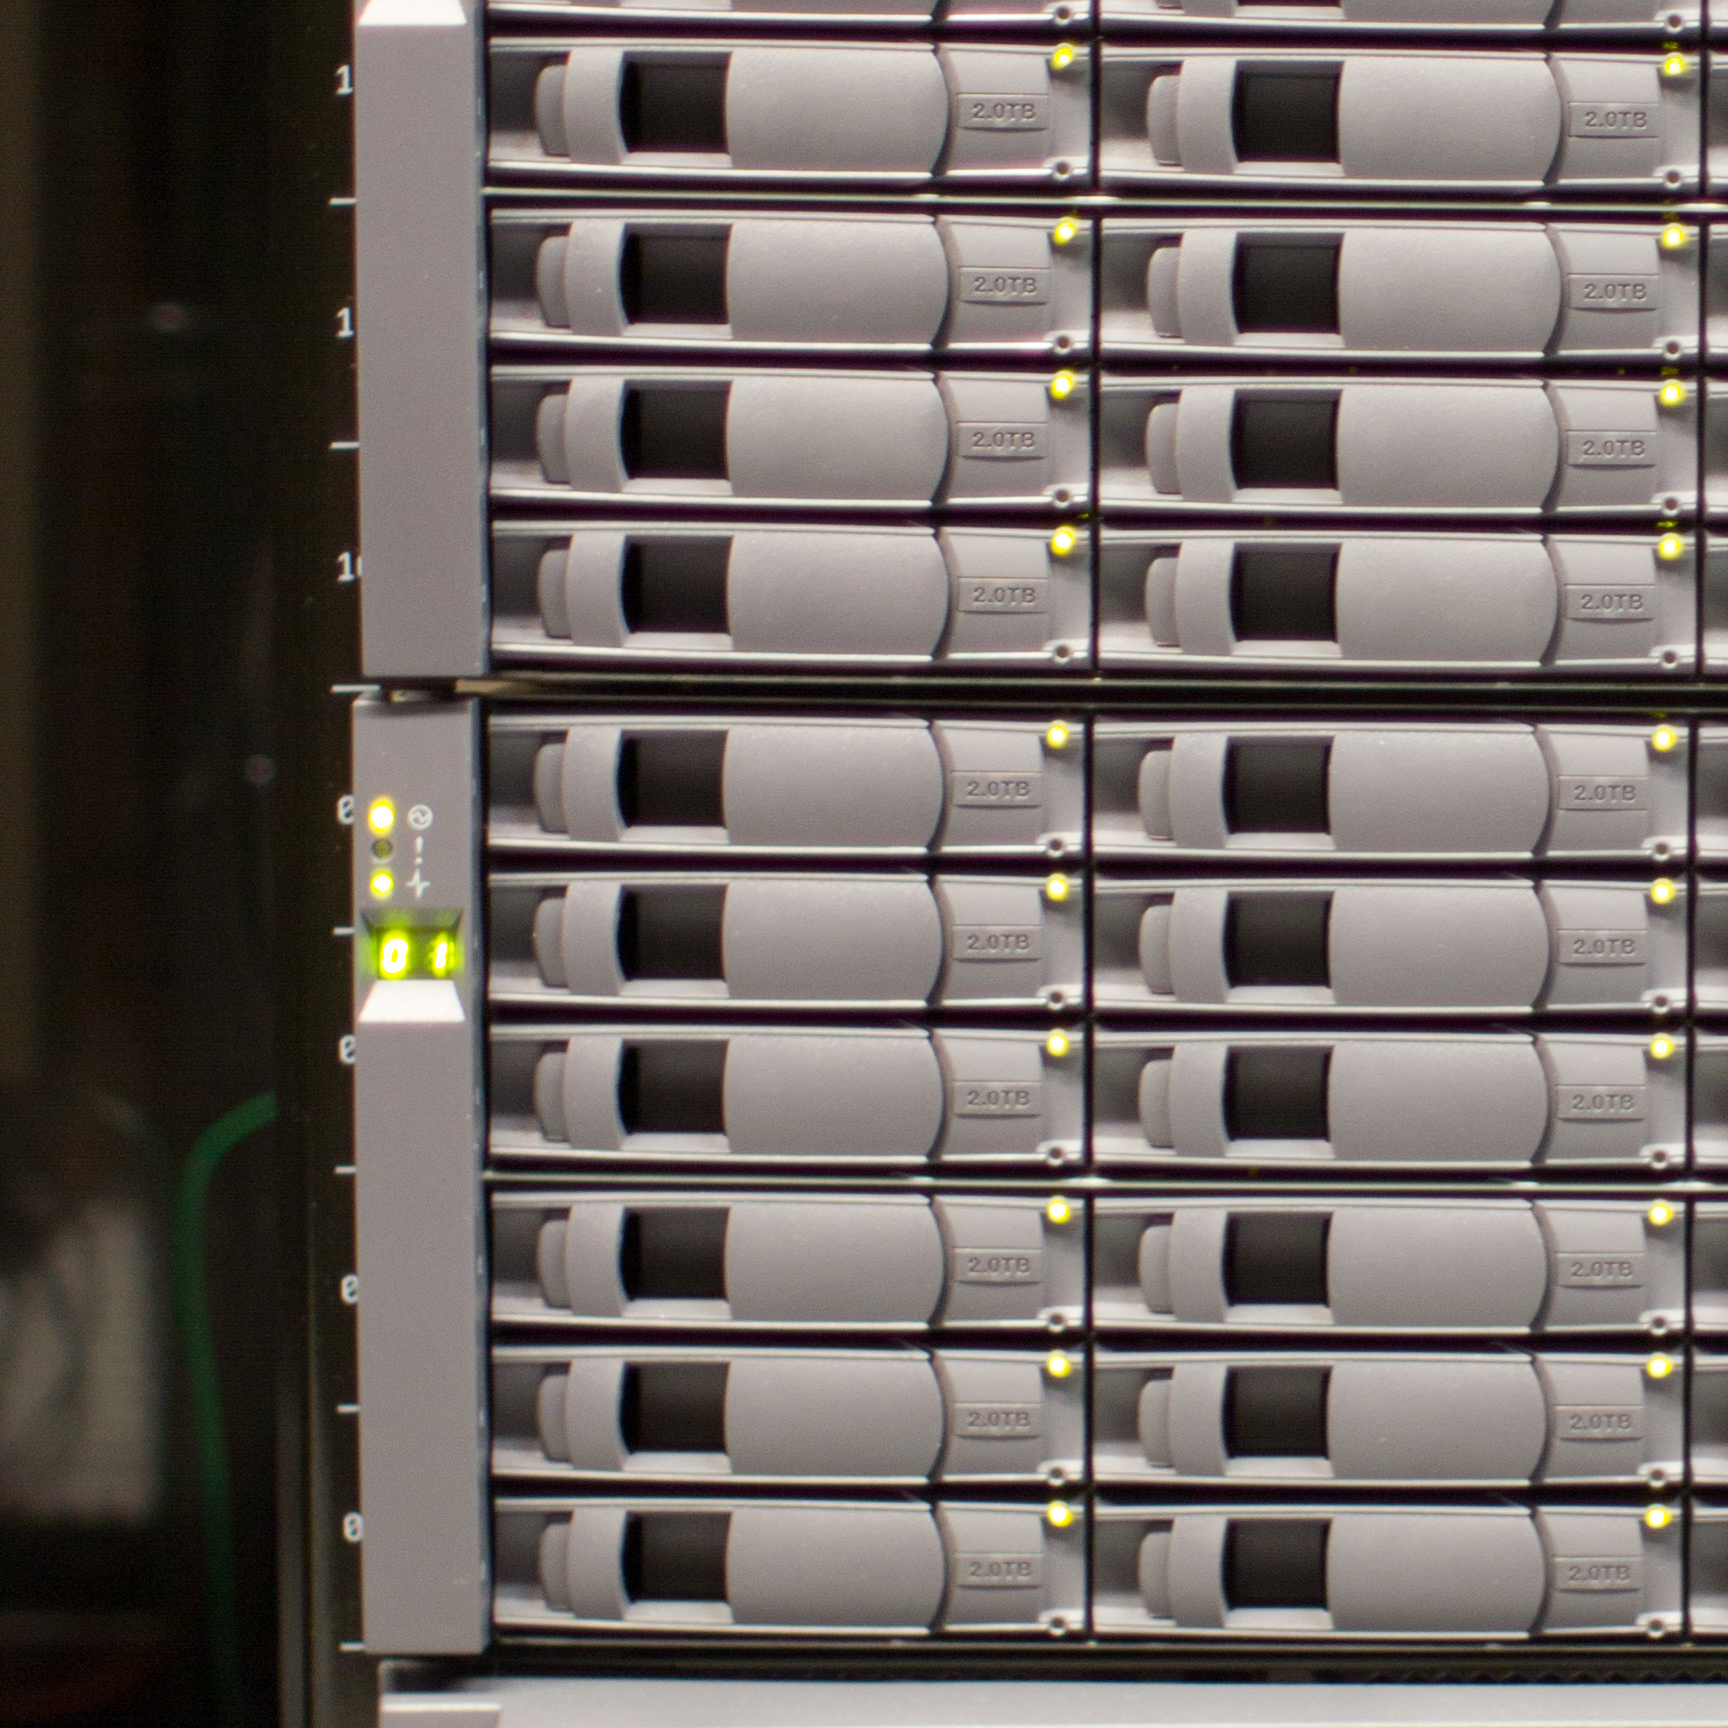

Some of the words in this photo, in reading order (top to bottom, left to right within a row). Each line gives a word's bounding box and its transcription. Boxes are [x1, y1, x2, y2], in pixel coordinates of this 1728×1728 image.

[971, 101, 1036, 120] 2.0TB
[1584, 109, 1649, 128] 2.0TB
[973, 275, 1038, 294] 2.0TB
[1583, 281, 1648, 300] 2.0TB
[971, 429, 1036, 449] 2.0TB
[1581, 438, 1646, 457] 2.0TB
[972, 585, 1037, 604] 2.0TB
[1580, 592, 1645, 611] 2.0TB
[966, 779, 1031, 798] 2.0TB
[1573, 782, 1638, 802] 2.0TB
[966, 932, 1031, 951] 2.0TB
[1572, 936, 1637, 956] 2.0TB
[966, 1088, 1031, 1107] 2.0TB
[1571, 1092, 1636, 1111] 2.0TB
[967, 1255, 1032, 1274] 2.0TB
[1570, 1259, 1635, 1278] 2.0TB
[967, 1409, 1032, 1428] 2.0TB
[1568, 1412, 1633, 1431] 2.0TB
[968, 1559, 1033, 1578] 2.0TB
[1567, 1563, 1632, 1582] 2.0TB
